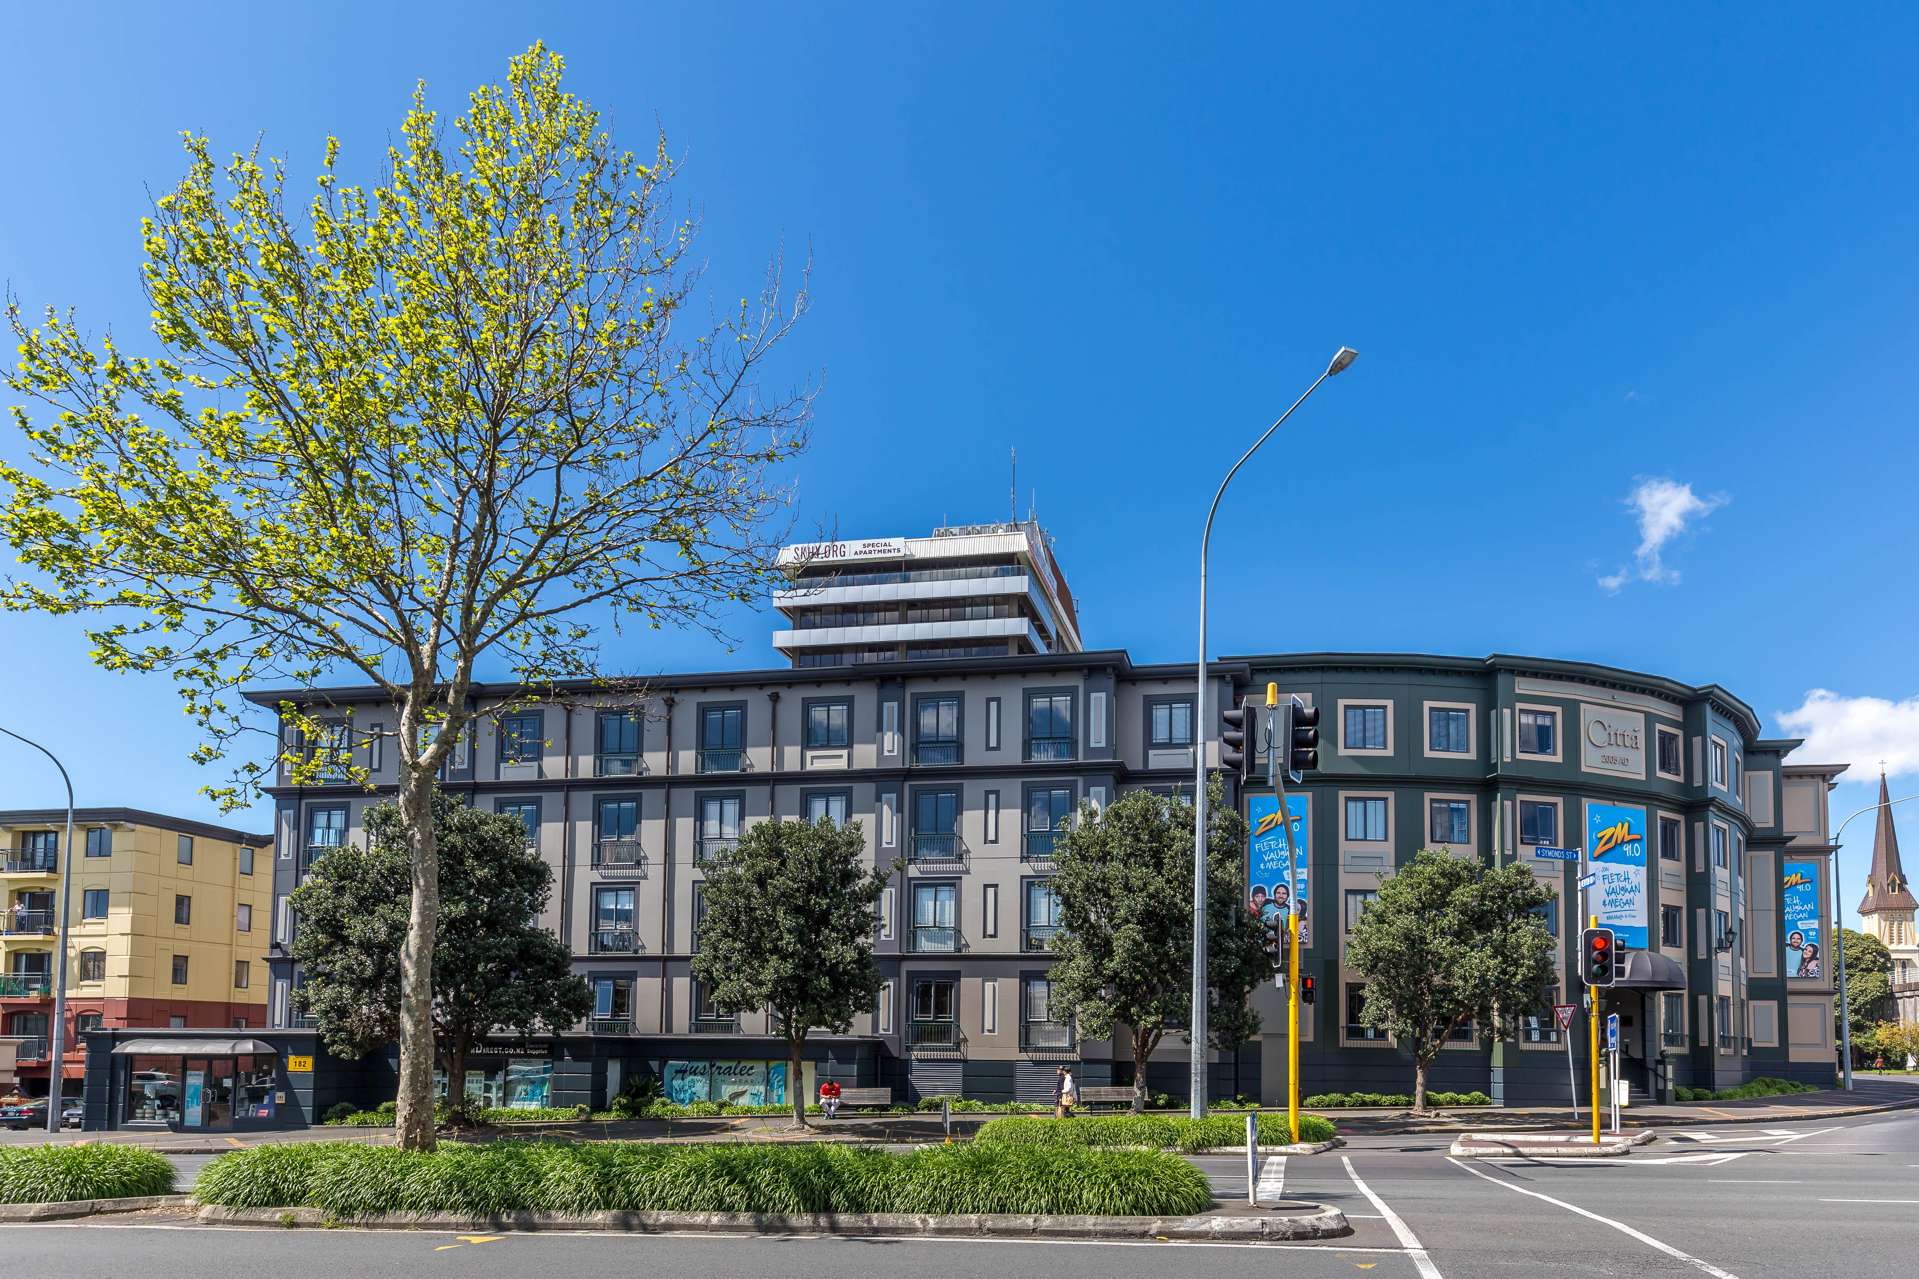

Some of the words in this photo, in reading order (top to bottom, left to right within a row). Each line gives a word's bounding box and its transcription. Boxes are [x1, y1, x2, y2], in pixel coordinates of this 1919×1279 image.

[862, 541, 892, 549] SPECIAL
[853, 548, 901, 556] APARTMENTS
[1593, 821, 1641, 858] ZM
[1541, 849, 1565, 858] SYMONDS
[1566, 851, 1572, 859] ST
[1623, 844, 1641, 857] 91.0
[1797, 883, 1812, 892] 91.0
[294, 1060, 307, 1068] 182
